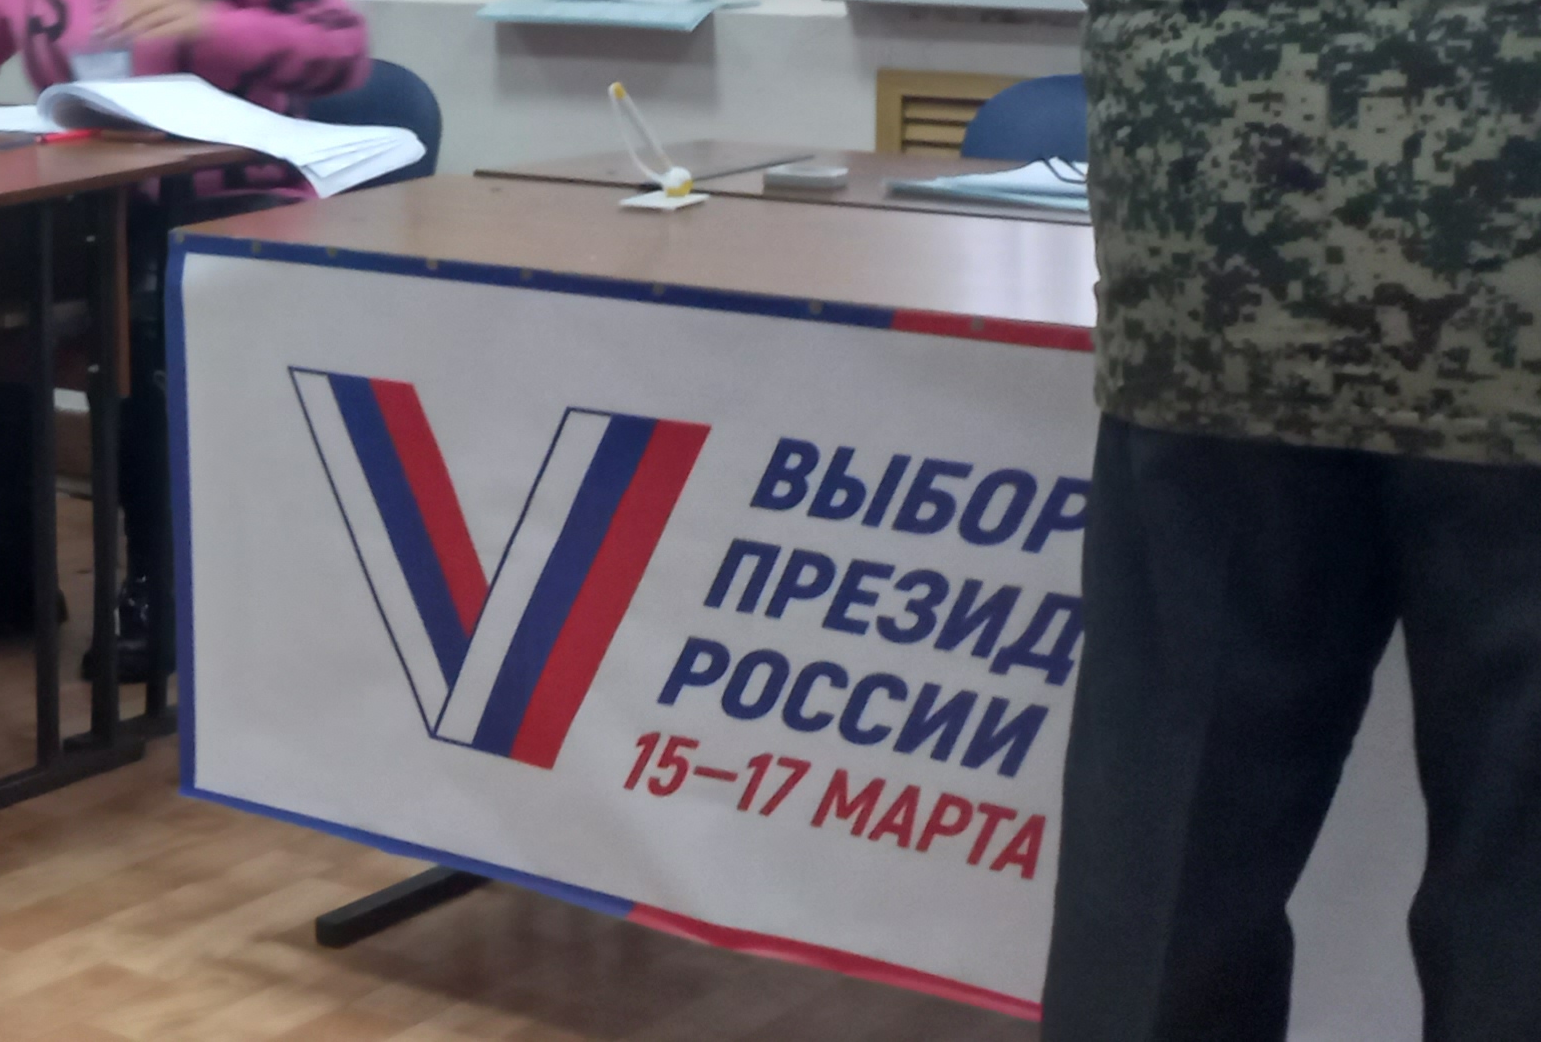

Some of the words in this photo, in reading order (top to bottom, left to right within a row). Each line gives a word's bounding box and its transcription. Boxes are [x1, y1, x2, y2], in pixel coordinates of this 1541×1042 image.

[749, 436, 1091, 554] ВЫБОР
[702, 537, 1083, 687] ПРЕЗИД
[656, 635, 1050, 778] РОССИИ
[811, 768, 1047, 880] МАРТА
